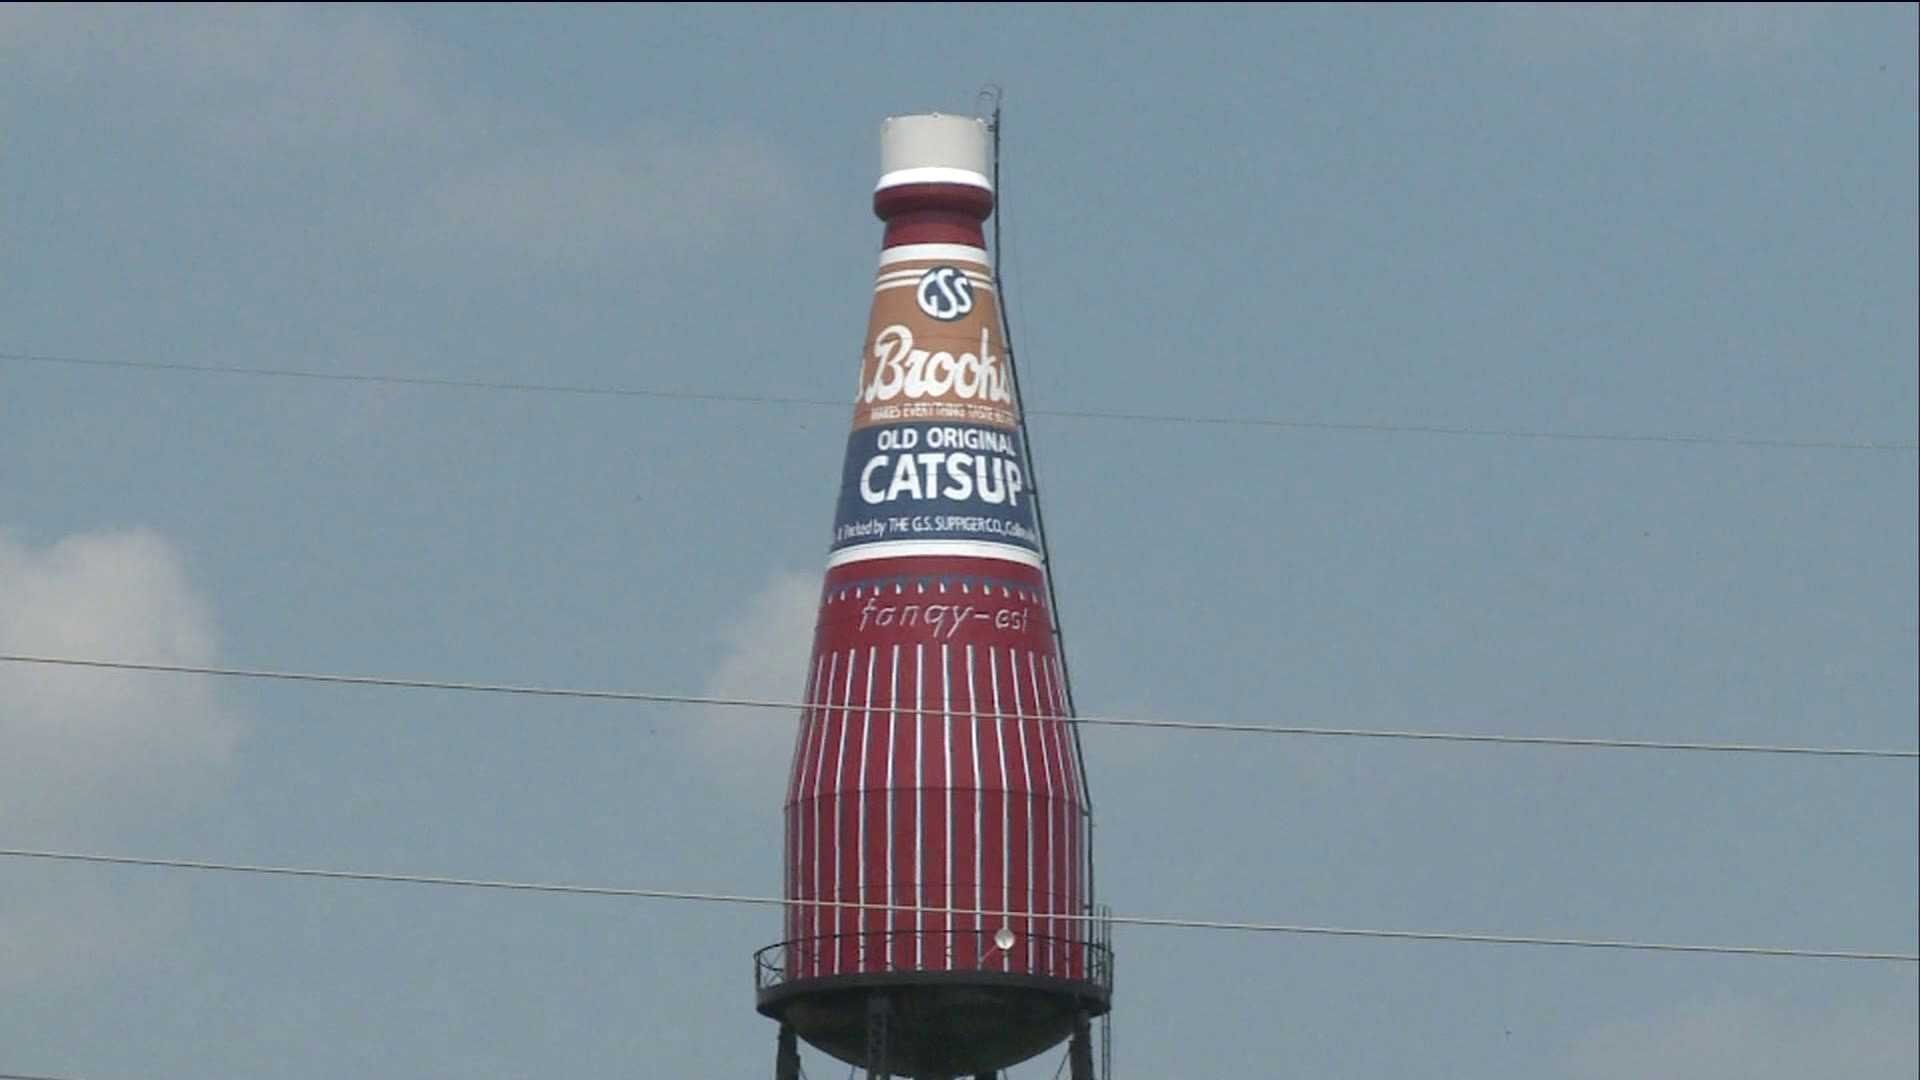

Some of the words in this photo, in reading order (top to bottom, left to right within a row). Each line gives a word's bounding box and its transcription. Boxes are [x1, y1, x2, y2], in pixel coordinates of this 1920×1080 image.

[917, 268, 972, 319] GSS
[878, 428, 918, 451] OLD
[926, 428, 1016, 456] ORIGINAL
[860, 452, 1022, 506] CATSUP
[888, 517, 909, 533] THE
